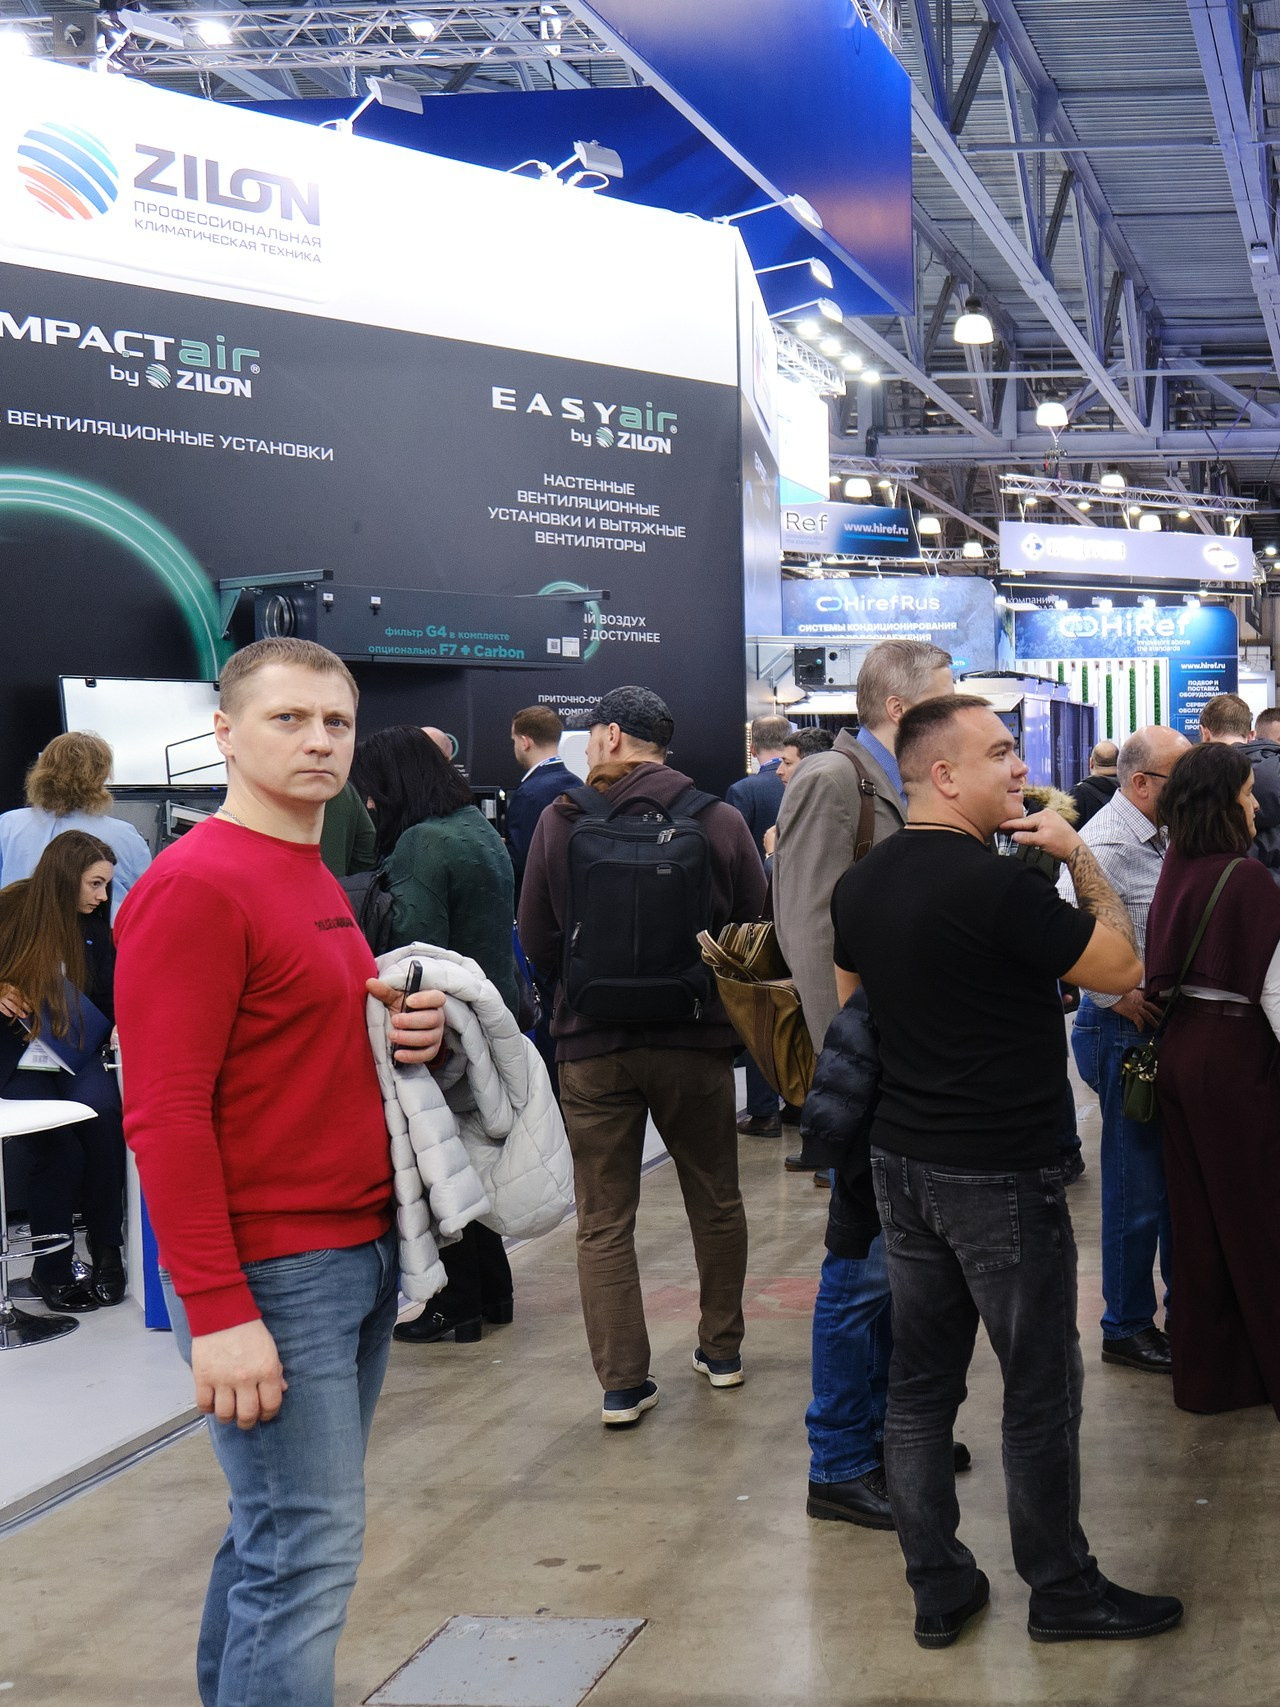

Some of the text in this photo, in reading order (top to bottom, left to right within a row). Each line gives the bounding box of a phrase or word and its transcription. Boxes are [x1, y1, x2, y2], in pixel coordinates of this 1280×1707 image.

[134, 143, 320, 226] ZILON
[134, 200, 321, 248] ПРОФЕССИОНАЛЬНАЯ
[134, 219, 321, 264] КЛИМАТИЧЕСКАЯ ТЕХНИКА
[110, 364, 252, 398] by ZILON
[7, 409, 334, 461] ВЕНТИЛЯЦИОННЫЕ УСТАНОВКИ
[571, 429, 671, 454] by ZILON
[544, 473, 635, 495] НАСТЕННЫЕ
[517, 490, 660, 517] ВЕНТИЛЯЦИОННЫЕ
[488, 506, 686, 538] УСТАНОВКИ И ВЫТЯЖНЫЕ
[786, 512, 909, 536] Ref www.hiref.ru
[535, 531, 646, 552] ВЕНТИЛЯТОРЫ
[385, 626, 423, 640] фильтр
[426, 625, 447, 638] G4
[458, 631, 510, 641] комплекте
[600, 615, 646, 627] ВОЗДУХ
[798, 621, 957, 632] СИСТЕМЫ КОНДИЦИОНИРОВАНИЯ
[1102, 612, 1190, 637] HiRef
[590, 629, 661, 643] ДОСТУПНЕЕ
[368, 644, 437, 655] опционально
[439, 643, 458, 656] F7
[474, 644, 524, 659] Carbon
[1181, 662, 1226, 670] www.hiref.ru
